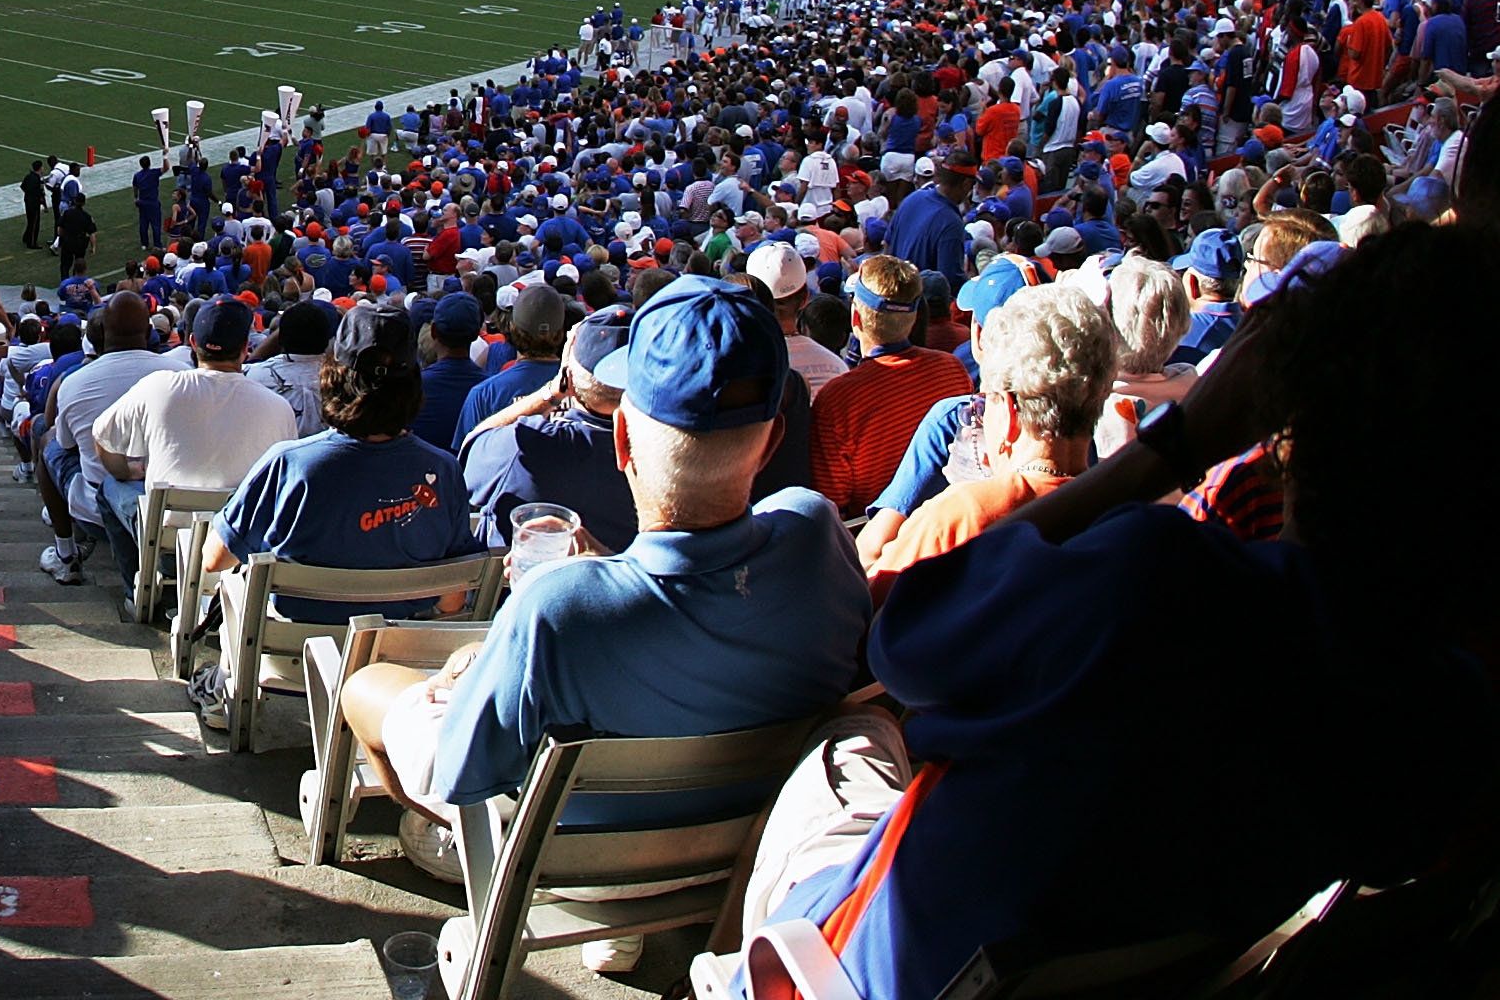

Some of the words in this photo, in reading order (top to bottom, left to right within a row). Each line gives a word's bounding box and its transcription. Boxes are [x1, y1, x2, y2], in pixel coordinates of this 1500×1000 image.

[462, 5, 519, 14] 40
[356, 21, 425, 33] 30
[220, 41, 304, 56] 20
[49, 68, 146, 84] 10
[359, 500, 419, 532] GATORS
